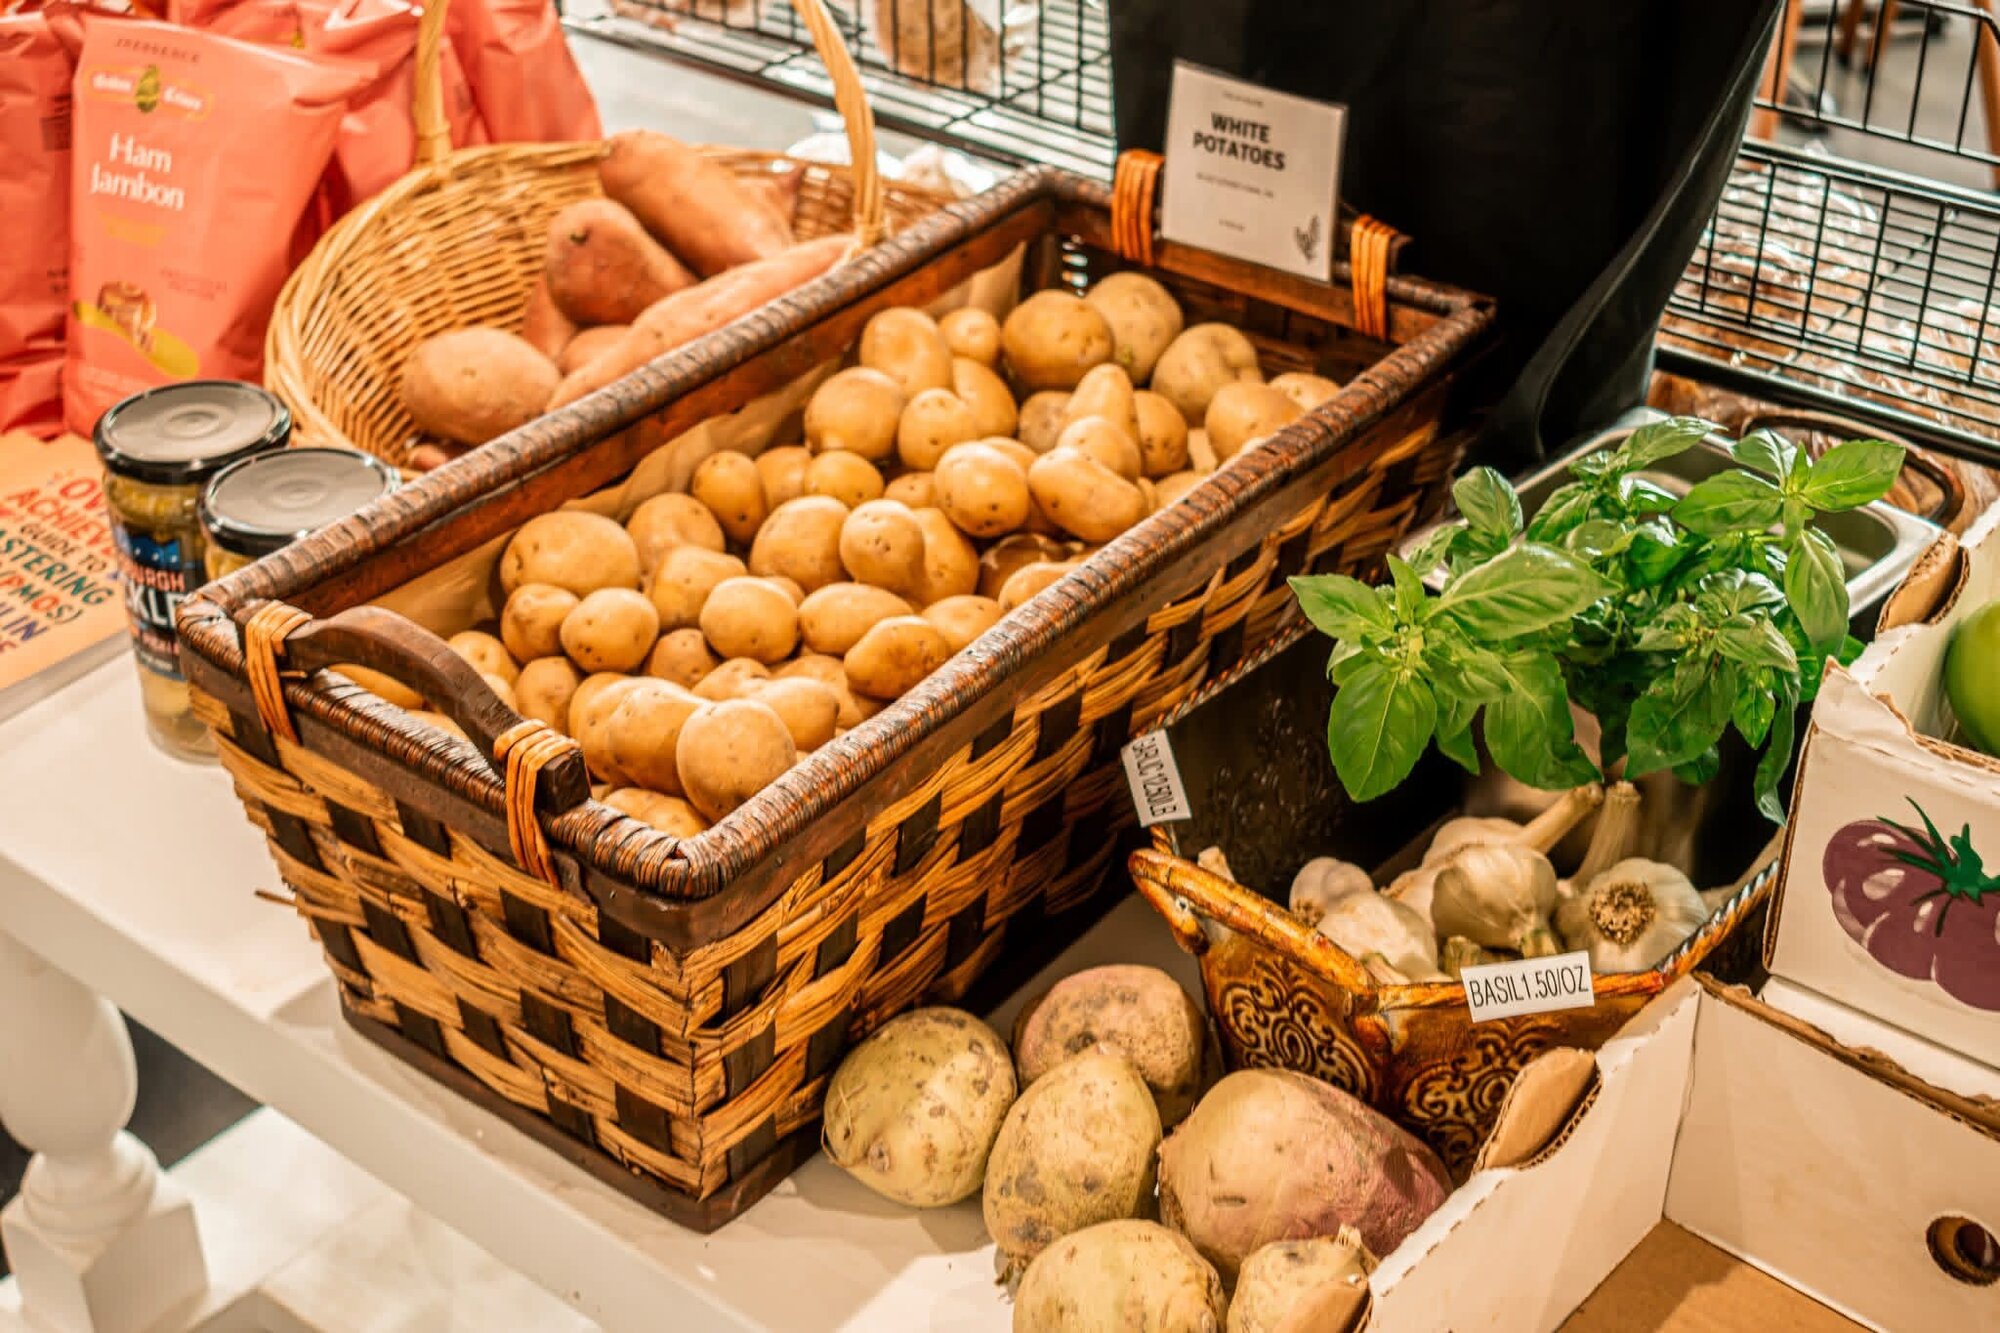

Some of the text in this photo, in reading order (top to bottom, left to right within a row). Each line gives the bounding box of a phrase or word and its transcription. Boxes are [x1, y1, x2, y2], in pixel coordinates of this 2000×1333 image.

[1211, 112, 1270, 143] WHITE
[108, 131, 172, 173] Ham
[1193, 131, 1286, 171] POTATOES
[90, 161, 186, 212] Jambon
[59, 478, 108, 512] OV
[0, 529, 114, 605] STERING
[78, 554, 108, 573] TO
